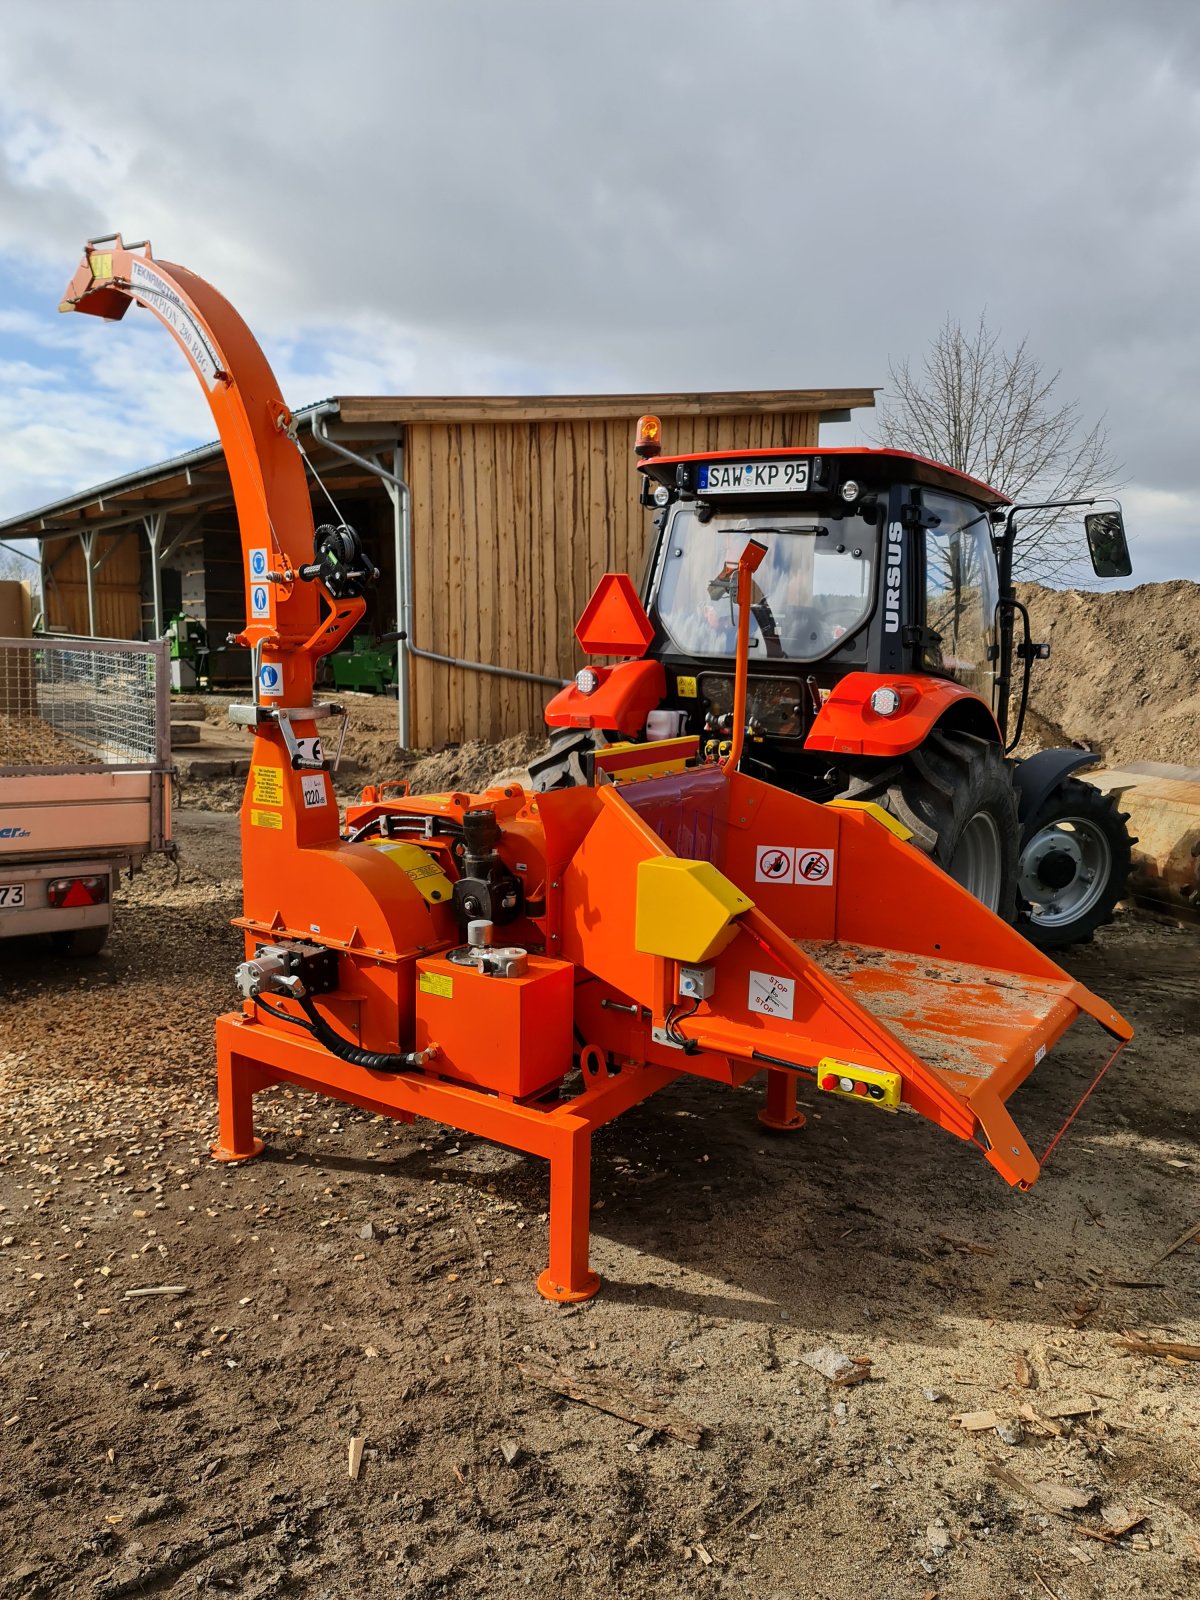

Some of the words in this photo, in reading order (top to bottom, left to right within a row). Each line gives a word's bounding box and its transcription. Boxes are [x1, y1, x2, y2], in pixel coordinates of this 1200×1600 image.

[709, 466, 744, 488] SAW
[755, 464, 779, 486] KP
[784, 463, 807, 485] 95
[885, 521, 903, 633] URSUS
[0, 886, 23, 905] 73
[768, 976, 788, 993] STOP
[755, 996, 774, 1013] STOP
